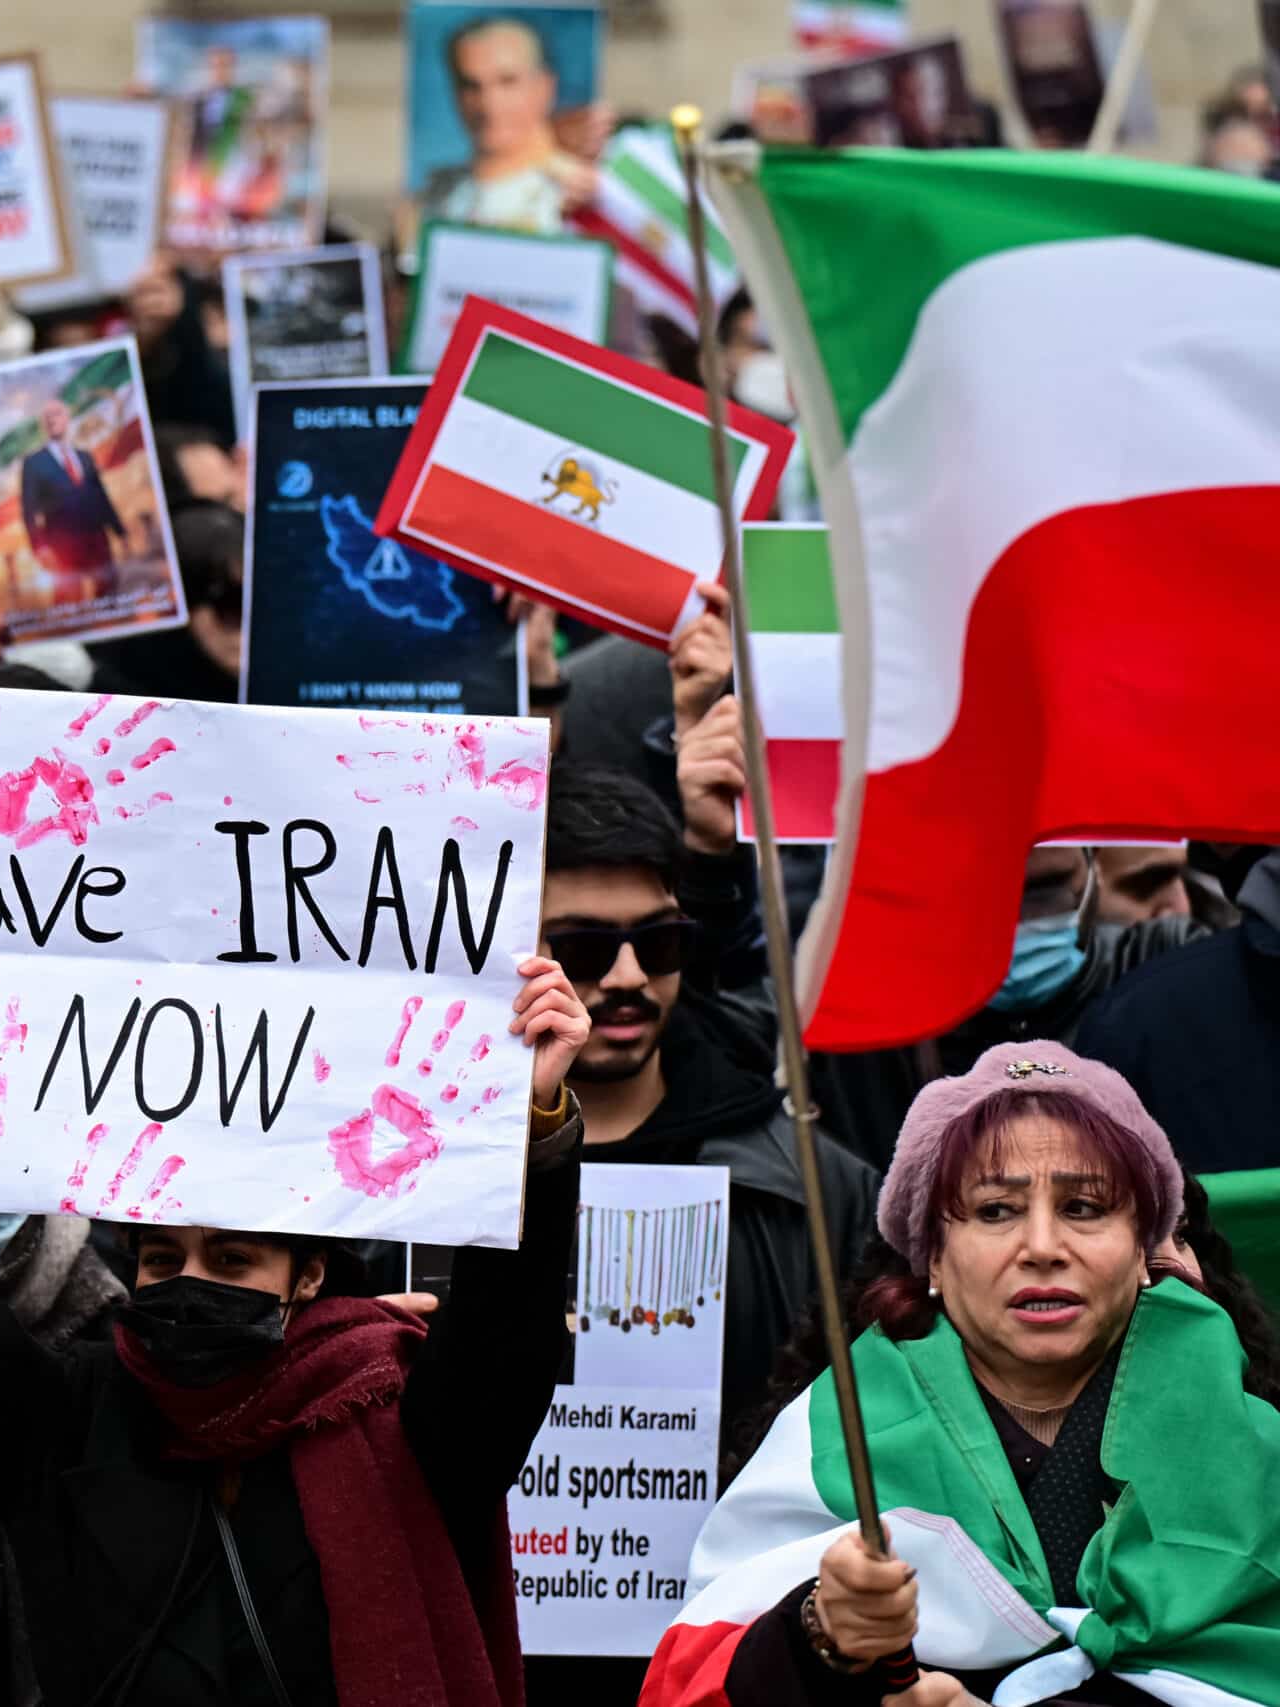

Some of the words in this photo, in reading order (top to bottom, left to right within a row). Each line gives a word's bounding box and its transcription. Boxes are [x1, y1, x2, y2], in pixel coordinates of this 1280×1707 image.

[294, 406, 372, 429] DIGITAL
[214, 819, 514, 975] IRAN
[34, 994, 315, 1133] NOW
[549, 1404, 613, 1429] Mehdi
[620, 1405, 696, 1431] Karami
[568, 1458, 707, 1508] sportsman
[511, 1526, 568, 1555] uted
[576, 1527, 604, 1563] by
[611, 1527, 650, 1557] the
[616, 1570, 640, 1599] of
